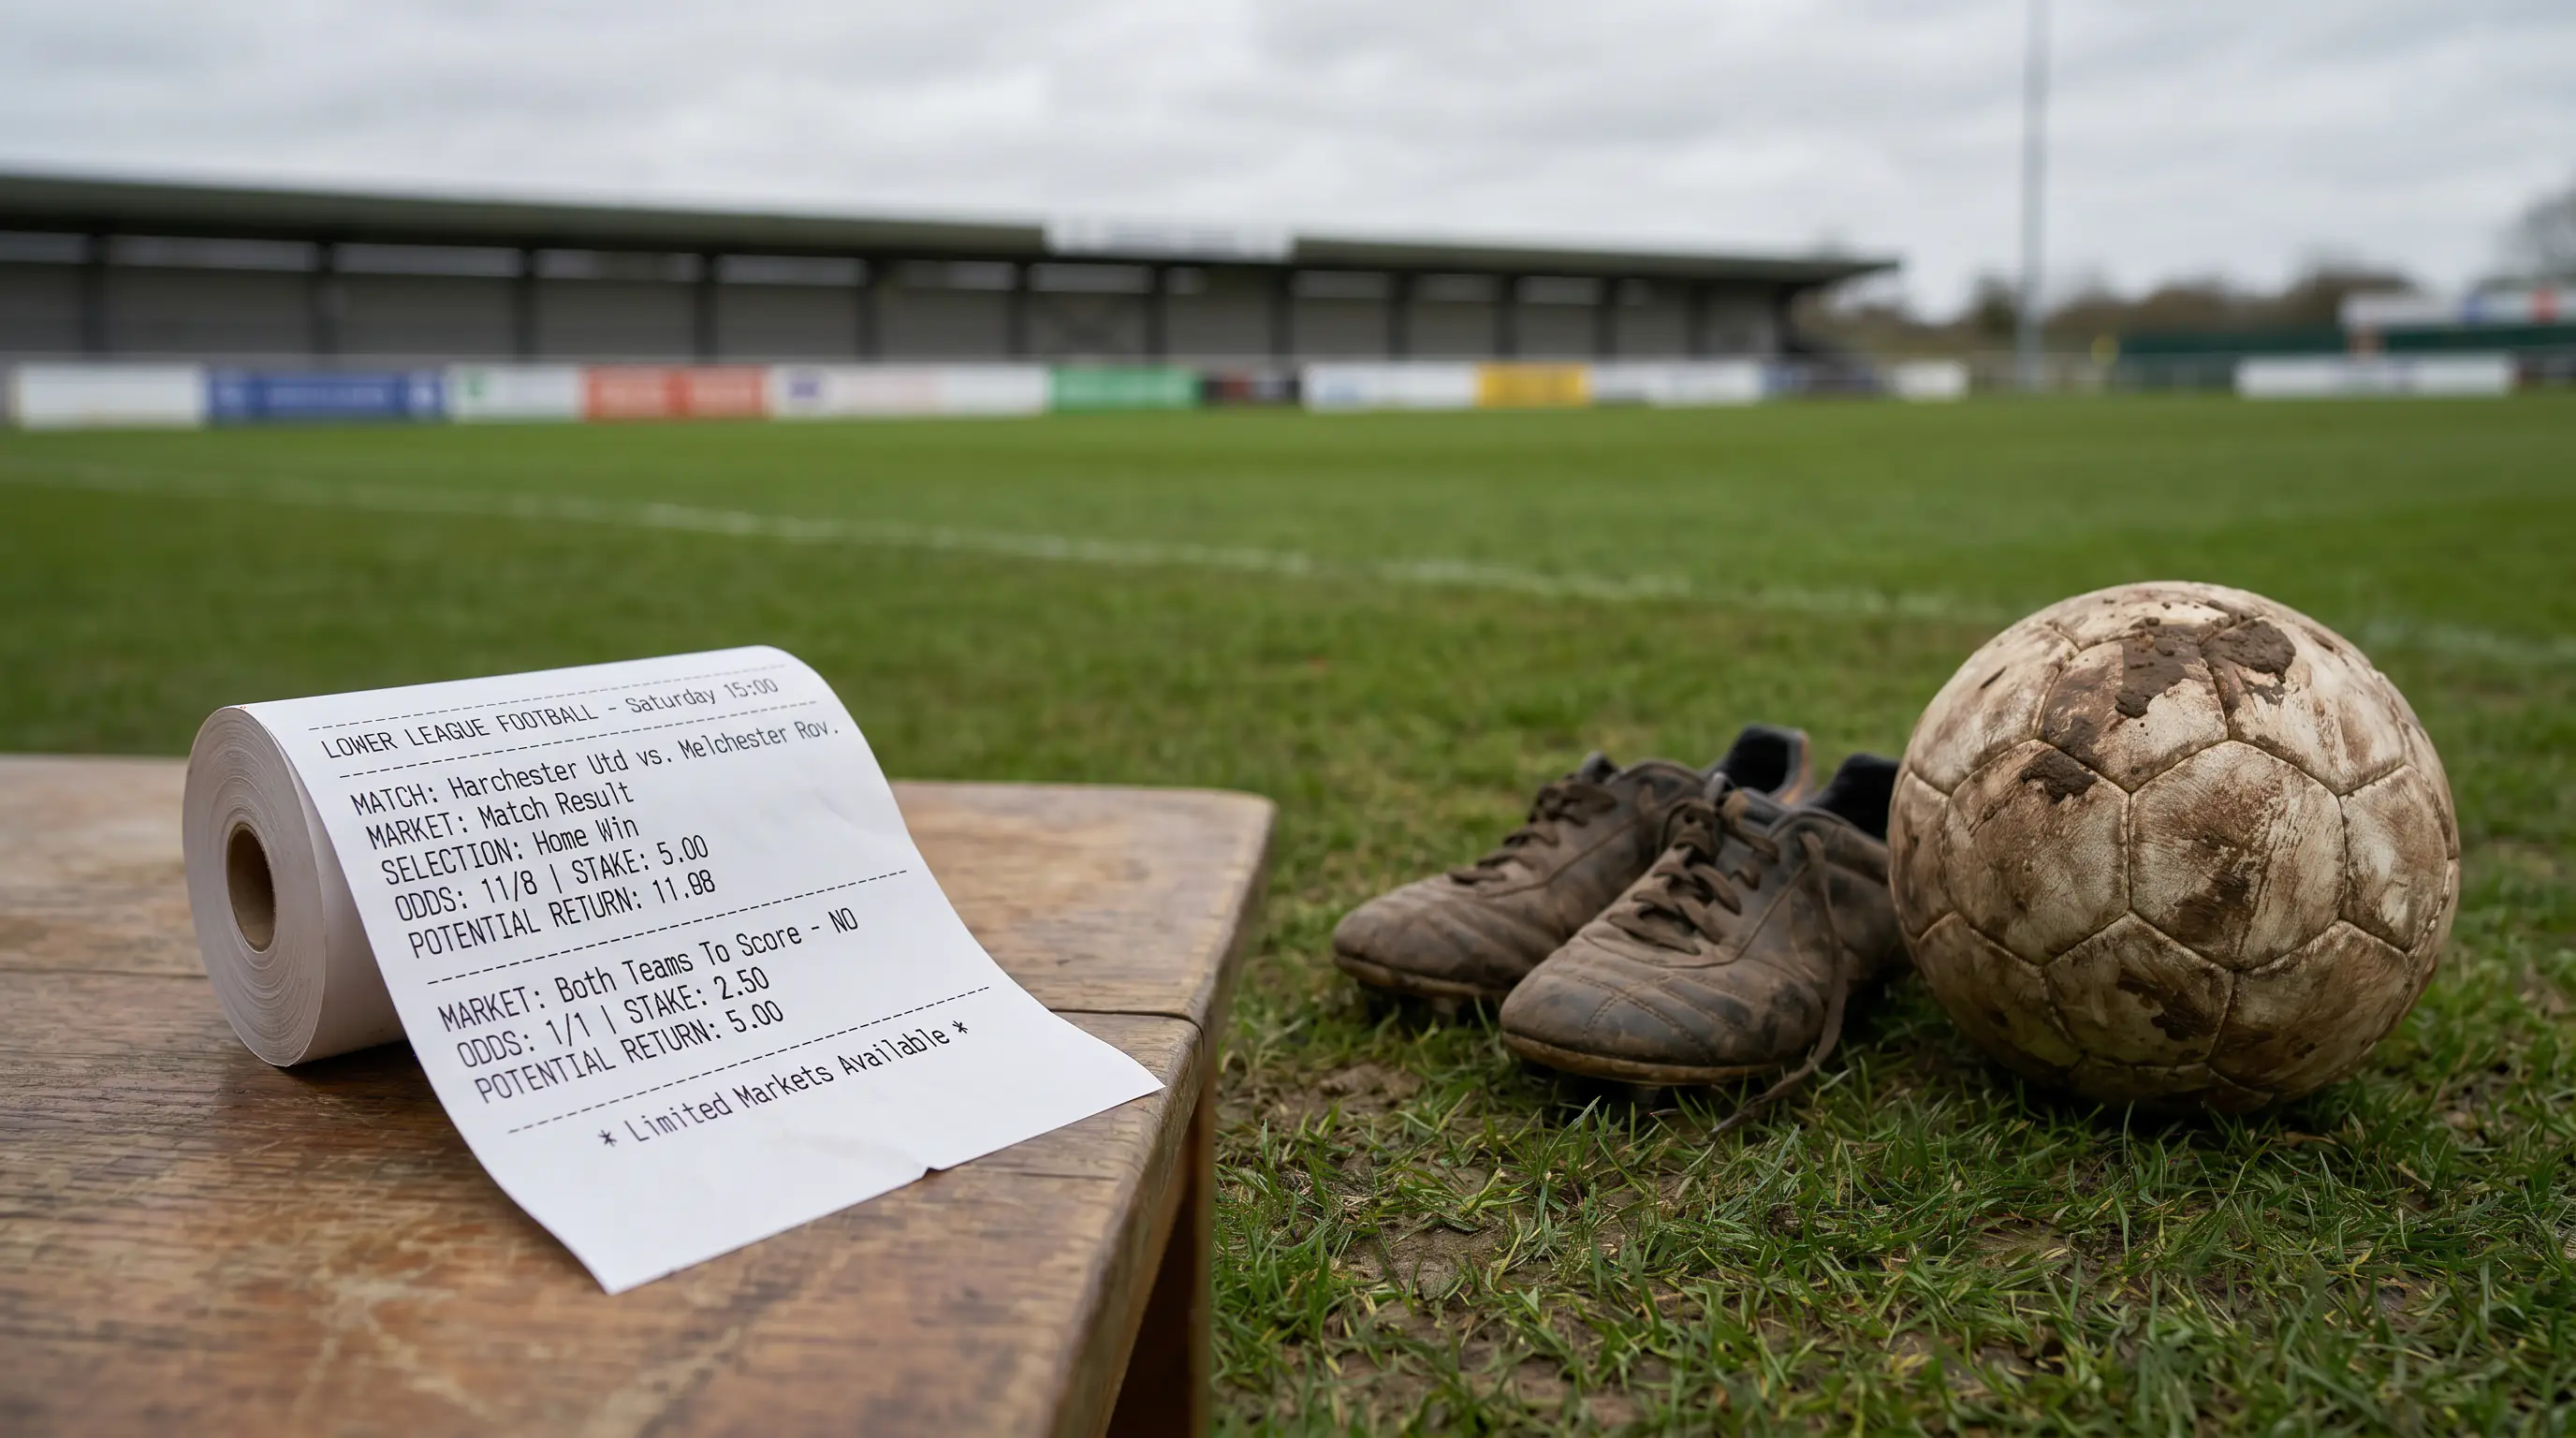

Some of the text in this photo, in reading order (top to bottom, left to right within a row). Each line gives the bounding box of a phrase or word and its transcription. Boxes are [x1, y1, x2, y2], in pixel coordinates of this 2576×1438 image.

[321, 732, 398, 758] LOWER
[404, 719, 490, 746] LEAGUE
[495, 705, 598, 733] FOOTBALL
[625, 689, 715, 712] Saturday
[724, 679, 778, 699] 15:00
[350, 720, 840, 816] MATCH: Harchester Utd vs. Melchester Rov.
[365, 782, 634, 850] MARKET: Match Result
[382, 816, 640, 886] SELECTION: Home Win
[395, 886, 468, 922] ODDS:
[481, 871, 537, 903] 11/8
[572, 849, 650, 884] STAKE:
[656, 834, 709, 866] 5.00
[408, 908, 541, 959] POTENTIAL
[548, 886, 642, 928] RETURN:
[437, 986, 546, 1033] MARKET:
[554, 966, 617, 1004] Both
[622, 953, 694, 986] Teams
[698, 940, 730, 965] To
[736, 926, 801, 956] Score
[828, 907, 858, 933] NO
[457, 1031, 535, 1068] ODDS:
[546, 1012, 592, 1047] 1/1
[623, 985, 708, 1024] STAKE:
[713, 966, 770, 1001] 2.50
[474, 1000, 784, 1104] POTENTIAL RETURN: 5.00
[623, 1029, 951, 1142] Limited Markets Available
